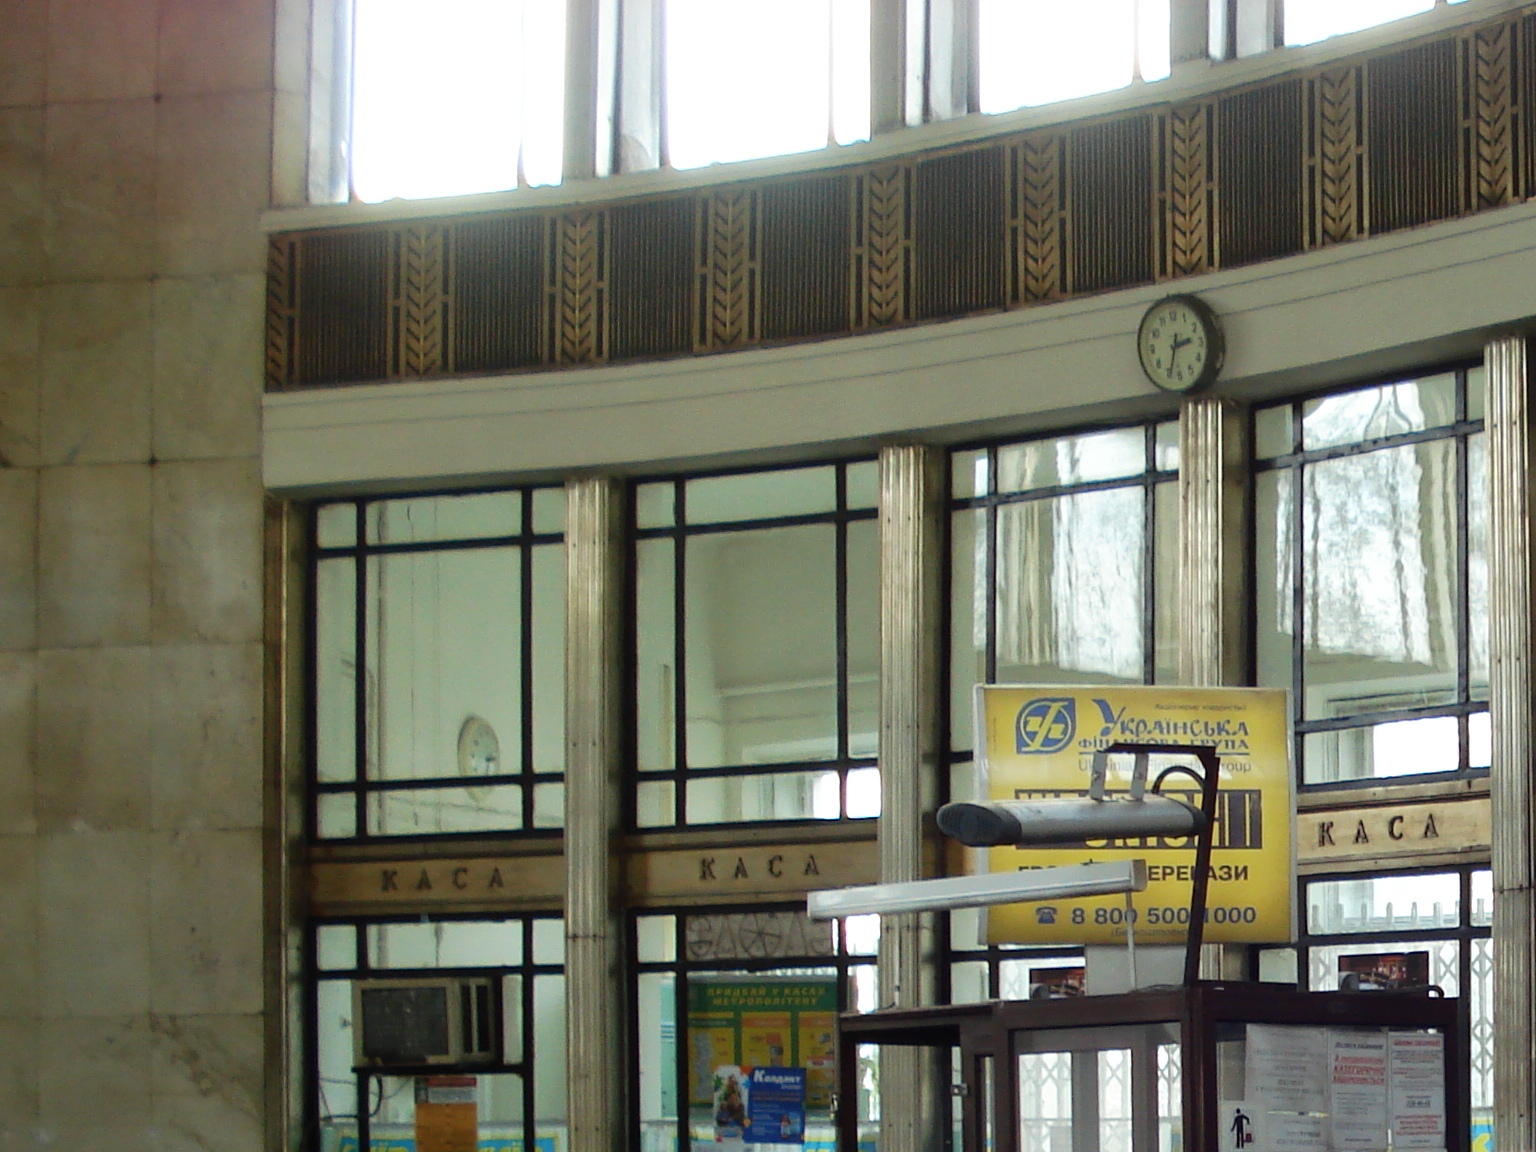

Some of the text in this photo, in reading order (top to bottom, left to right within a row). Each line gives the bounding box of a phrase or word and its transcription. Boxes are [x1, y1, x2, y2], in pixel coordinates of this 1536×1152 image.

[1221, 759, 1251, 773] roup
[1318, 813, 1440, 847] КАСА
[699, 854, 821, 881] КАСА
[1147, 865, 1249, 882] ЕРЕАЗИ
[381, 866, 505, 892] КАСА
[1071, 907, 1085, 925] 8
[1094, 907, 1138, 925] 800
[1147, 907, 1191, 925] 500
